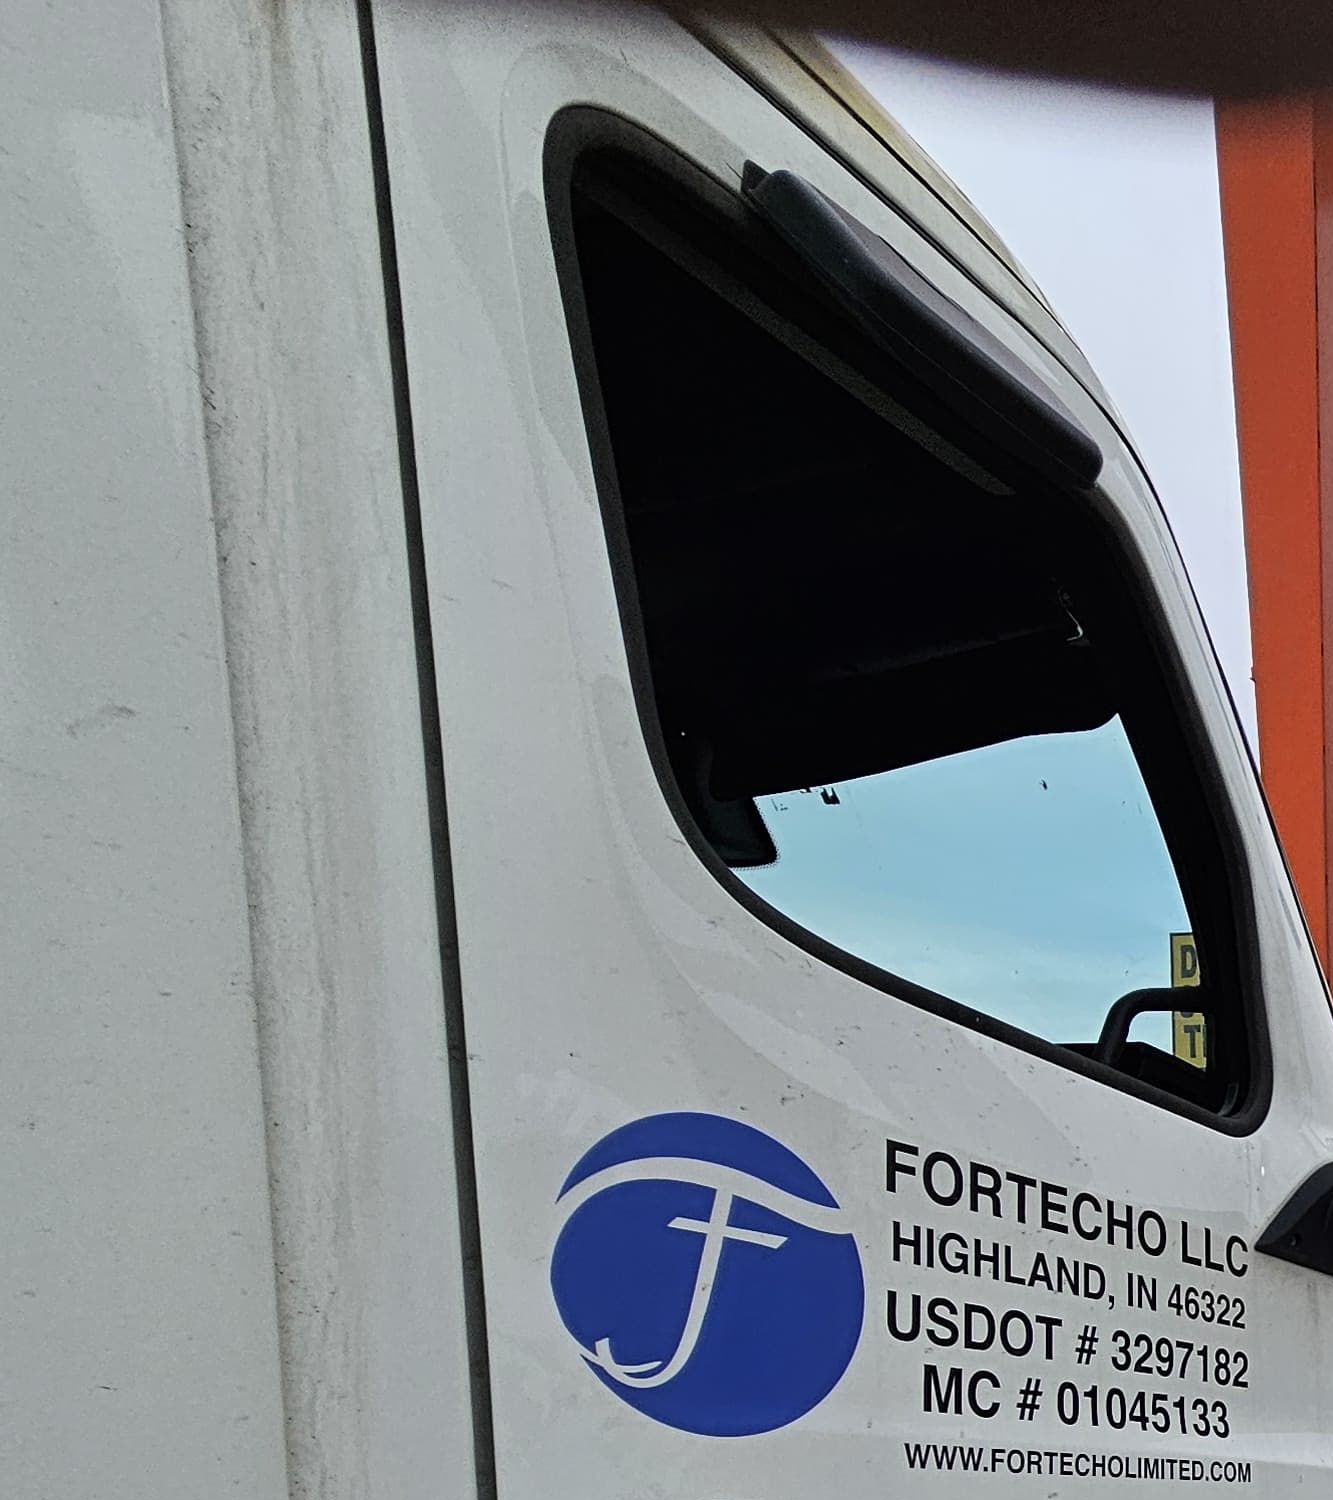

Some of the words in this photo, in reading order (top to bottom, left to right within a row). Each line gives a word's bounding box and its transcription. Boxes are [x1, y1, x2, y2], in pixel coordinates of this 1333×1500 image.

[886, 1138, 1167, 1257] FORTECHO
[1180, 1220, 1249, 1278] LLC
[892, 1220, 1115, 1310] HIGHLAND,
[1127, 1272, 1157, 1312] IN
[1167, 1283, 1246, 1328] 46322
[887, 1290, 1063, 1360] USDOT
[1075, 1324, 1099, 1365] #
[1111, 1330, 1249, 1388] 3297182
[922, 1363, 1001, 1418] MC
[1016, 1377, 1043, 1421] #
[1057, 1381, 1230, 1439] 01045133
[904, 1442, 1252, 1483] WWW.FORTECHOLIMITED.COM
